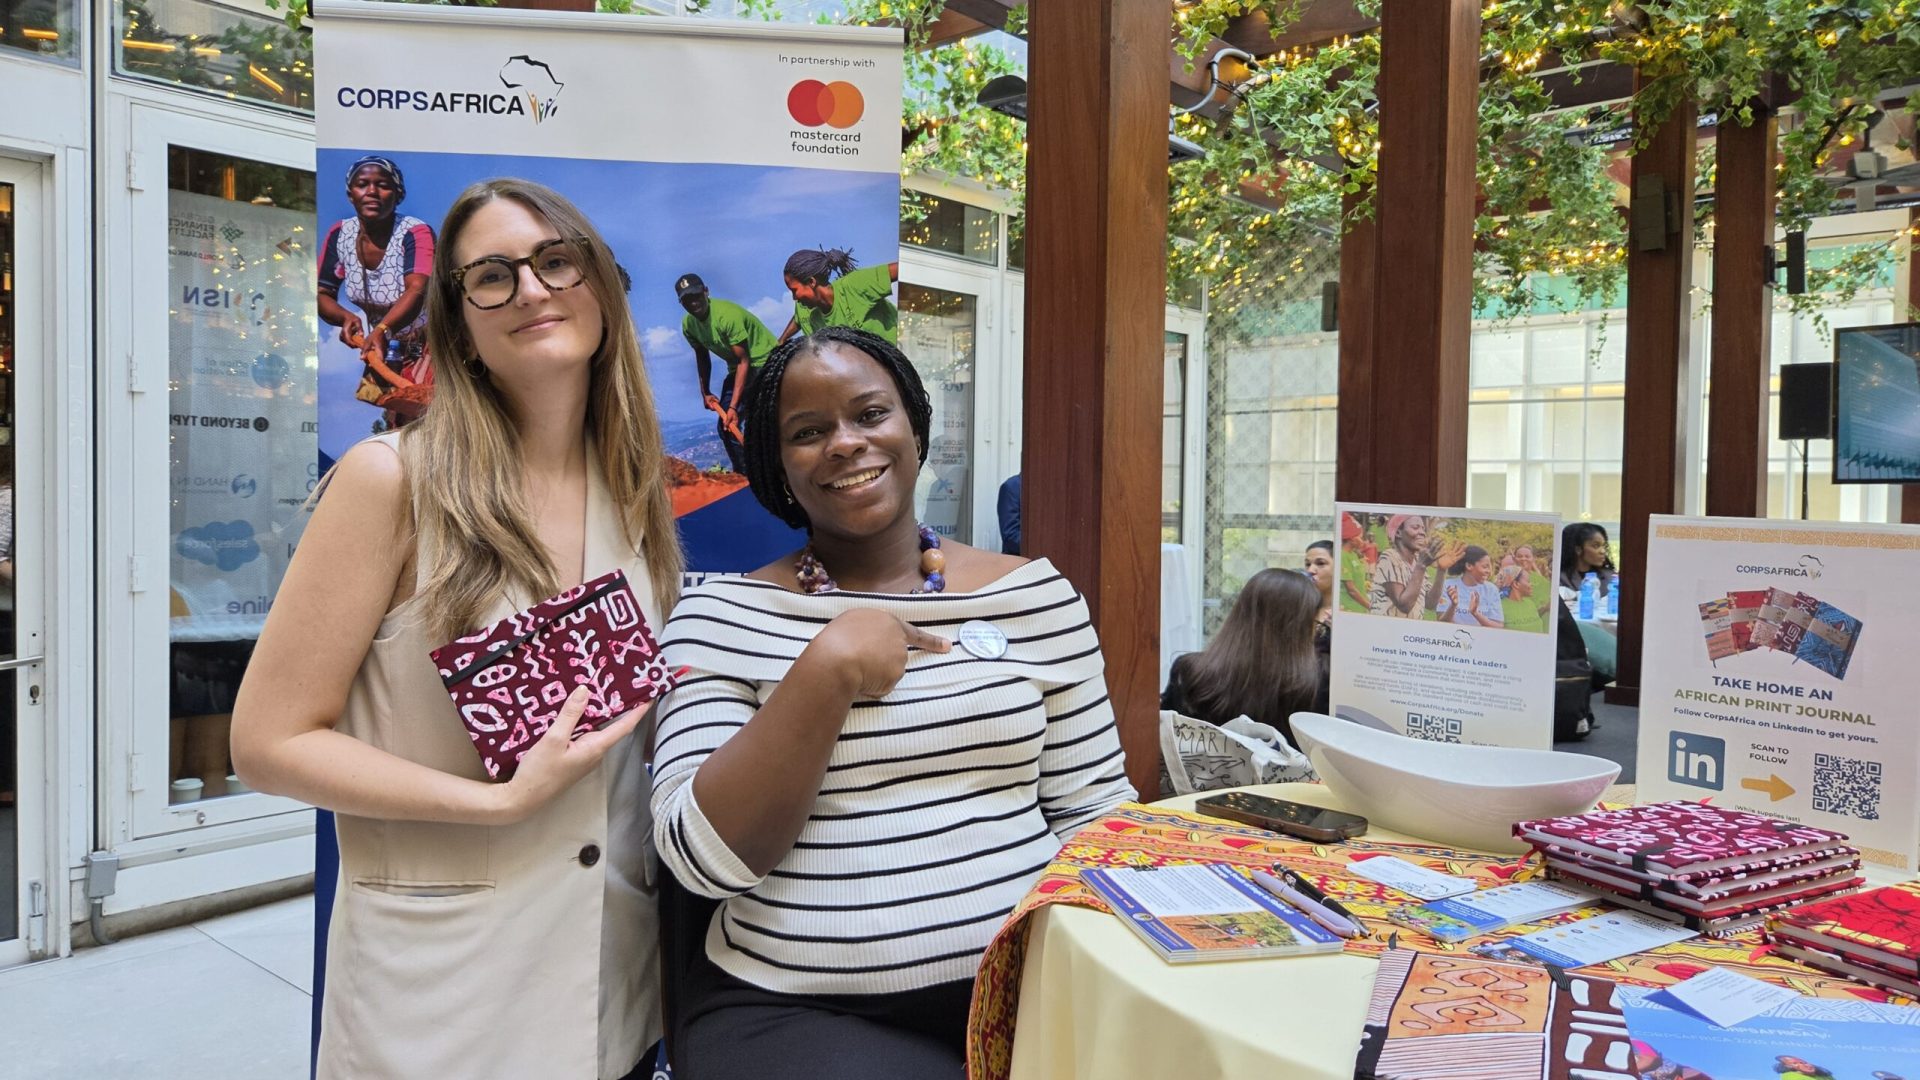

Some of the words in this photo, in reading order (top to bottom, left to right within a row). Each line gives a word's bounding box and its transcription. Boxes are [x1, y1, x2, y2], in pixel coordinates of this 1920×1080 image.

[778, 54, 788, 63] In
[790, 56, 850, 68] partnership
[852, 59, 875, 68] with
[337, 87, 525, 116] CORPSAFRICA
[790, 130, 861, 142] mastercard
[791, 141, 859, 156] foundation
[1736, 564, 1808, 577] CORPSAFRICA
[1403, 635, 1461, 648] CORPSAFRICA
[1372, 646, 1397, 655] Invest
[1399, 648, 1407, 656] in
[1409, 651, 1436, 661] Young
[1438, 655, 1470, 664] African
[1472, 659, 1508, 669] Leaders
[1712, 676, 1752, 690] TAKE
[1756, 681, 1804, 697] HOME
[1808, 688, 1833, 701] AN
[1674, 688, 1740, 706] AFRICAN
[1745, 698, 1792, 714] PRINT
[1796, 705, 1876, 726] JOURNAL
[1673, 707, 1701, 717] Follow
[1704, 712, 1756, 725] CorpsAfrica
[1772, 722, 1814, 734] LinkedIn
[1816, 728, 1826, 736] to
[1828, 731, 1845, 739] get
[1848, 733, 1879, 744] yours.
[1751, 743, 1775, 753] SCAN
[1777, 747, 1790, 755] TO
[1674, 737, 1717, 784] in
[1749, 752, 1788, 765] FOLLOW
[1757, 809, 1785, 819] supplies
[1785, 814, 1801, 822] last)
